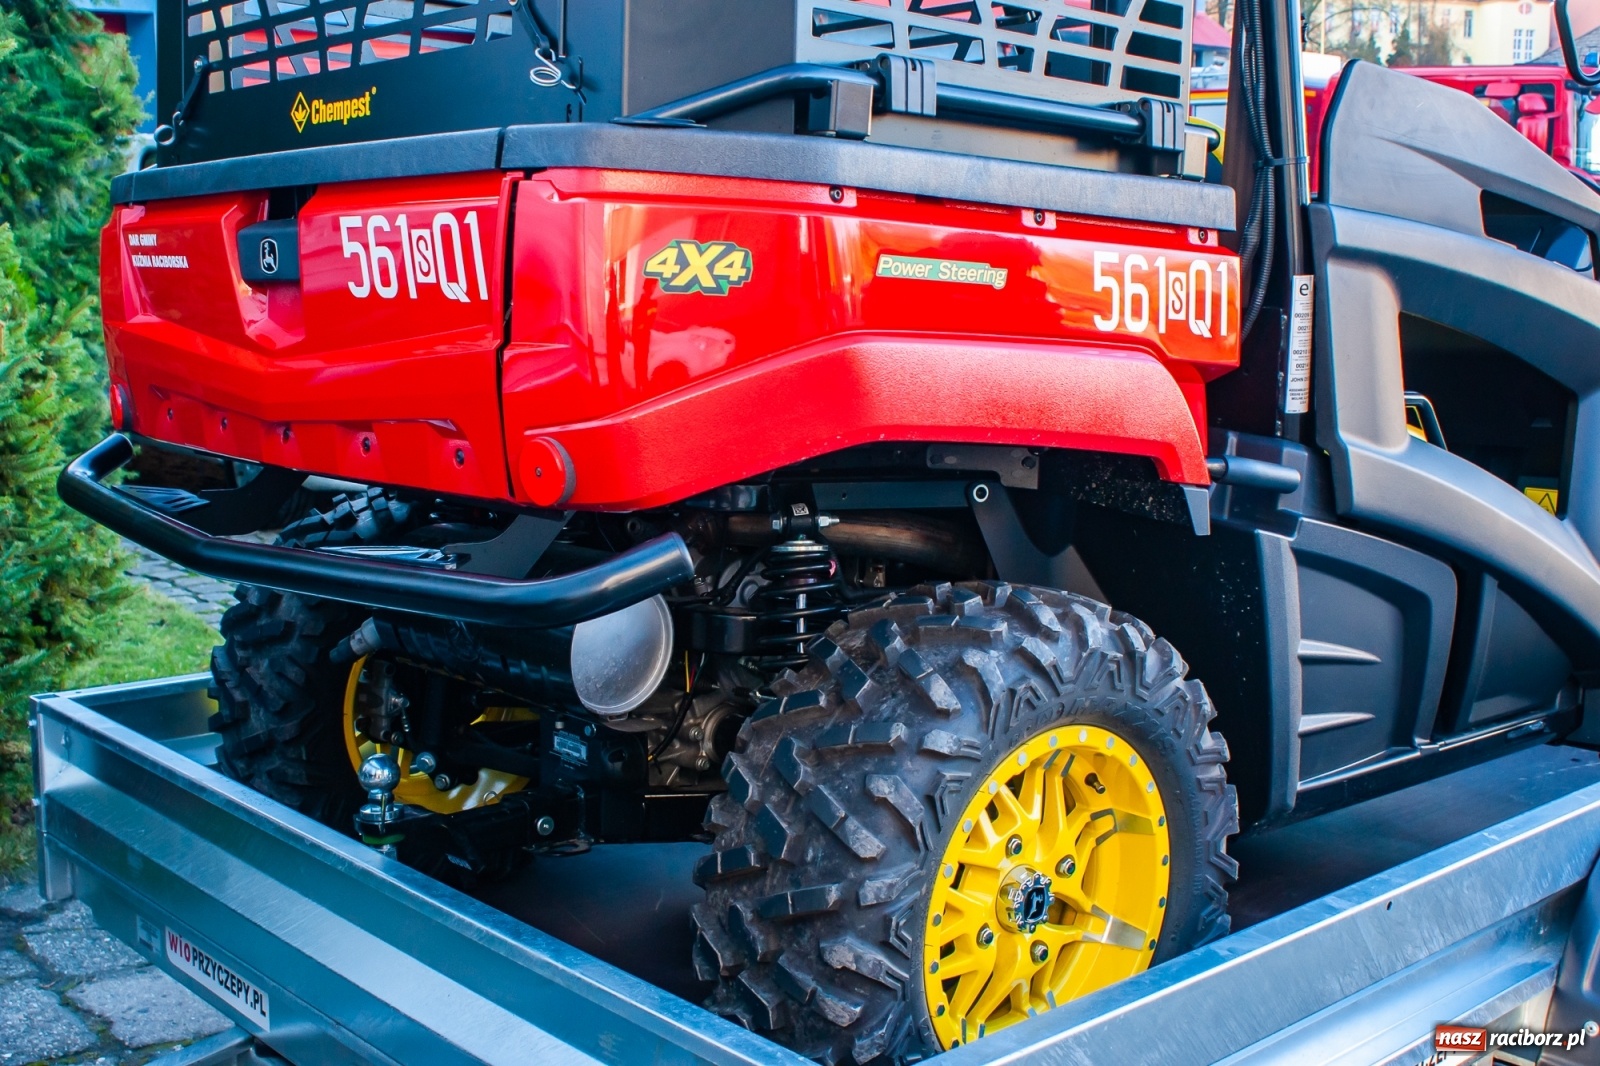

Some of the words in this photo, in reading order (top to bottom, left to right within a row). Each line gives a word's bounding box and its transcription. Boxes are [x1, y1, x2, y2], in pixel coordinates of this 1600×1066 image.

[311, 91, 371, 125] Chempest
[878, 256, 933, 278] Power
[938, 262, 1006, 287] Steering
[1299, 283, 1309, 296] e
